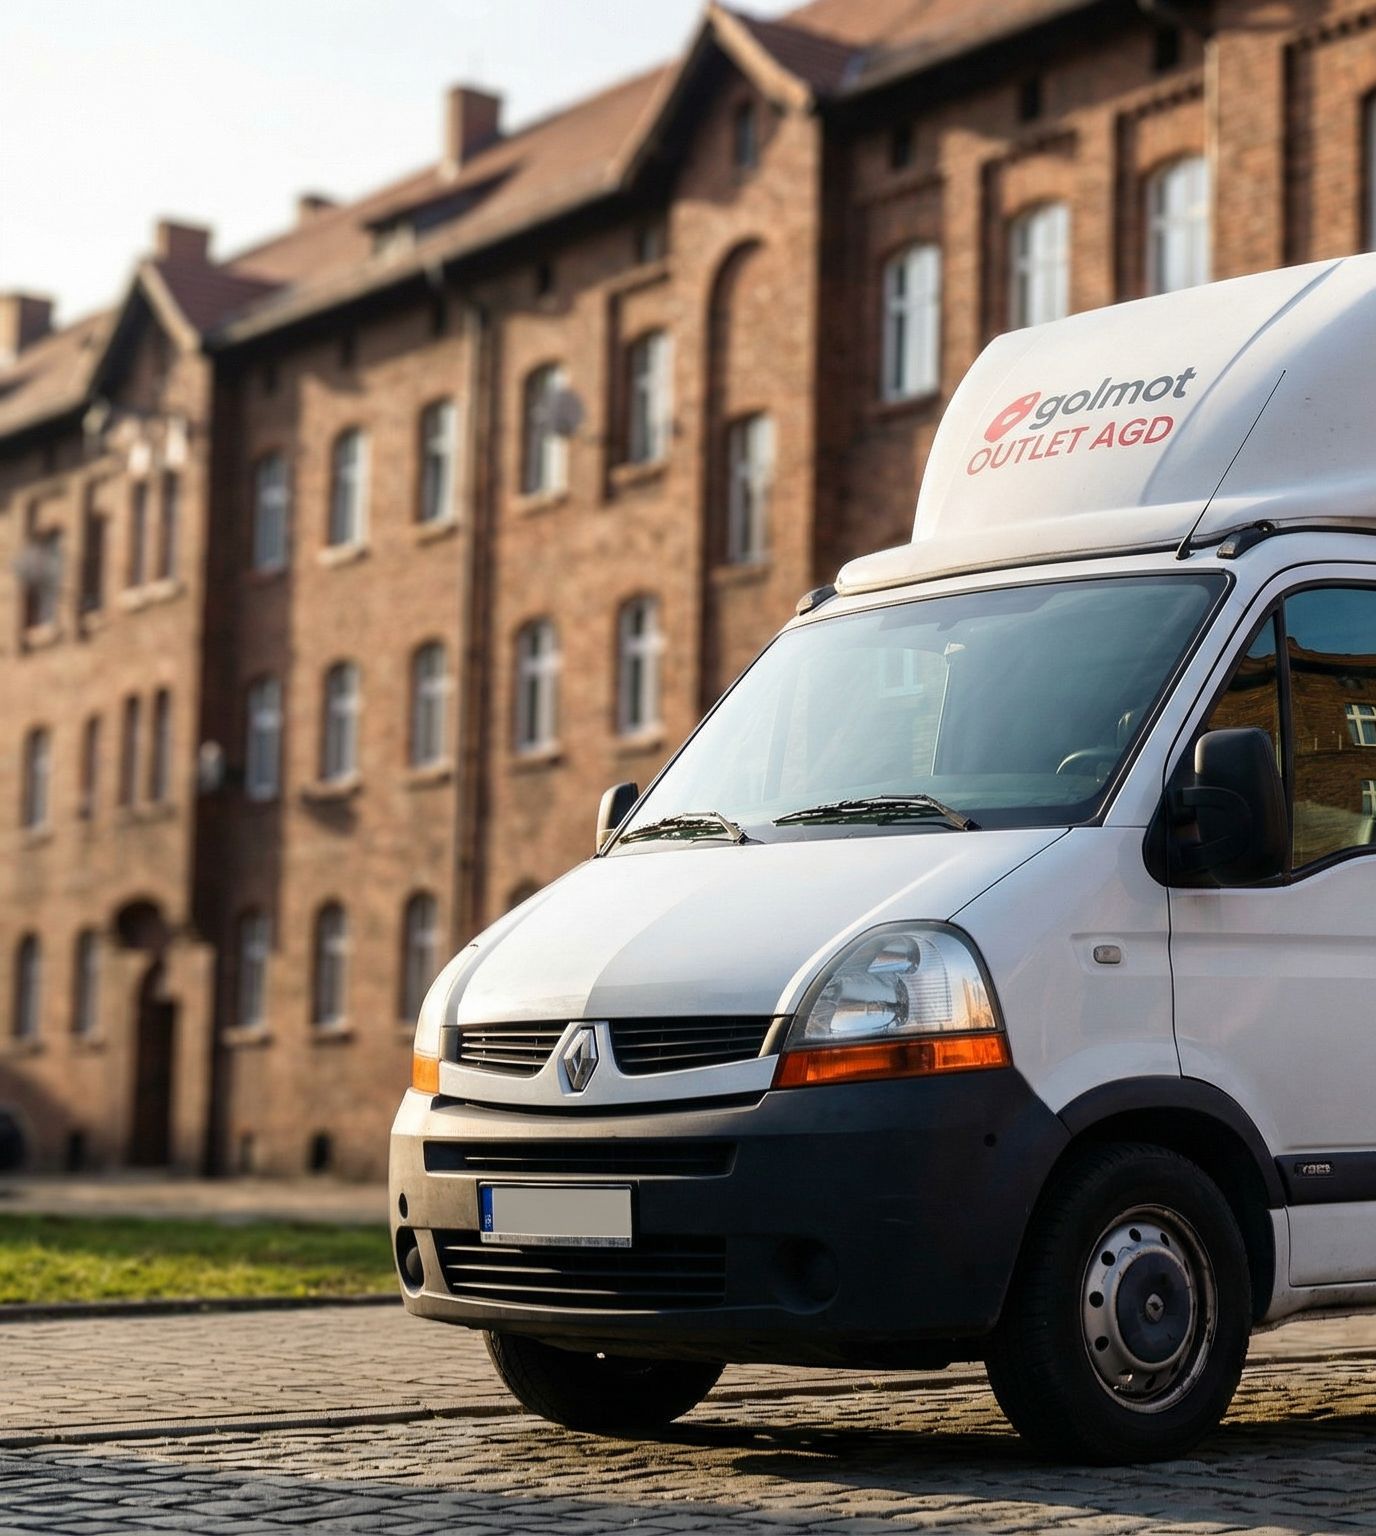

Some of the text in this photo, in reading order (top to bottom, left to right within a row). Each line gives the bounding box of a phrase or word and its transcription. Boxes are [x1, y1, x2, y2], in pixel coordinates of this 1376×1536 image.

[1029, 367, 1196, 430] golmot
[966, 415, 1175, 476] OUTLET AGD
